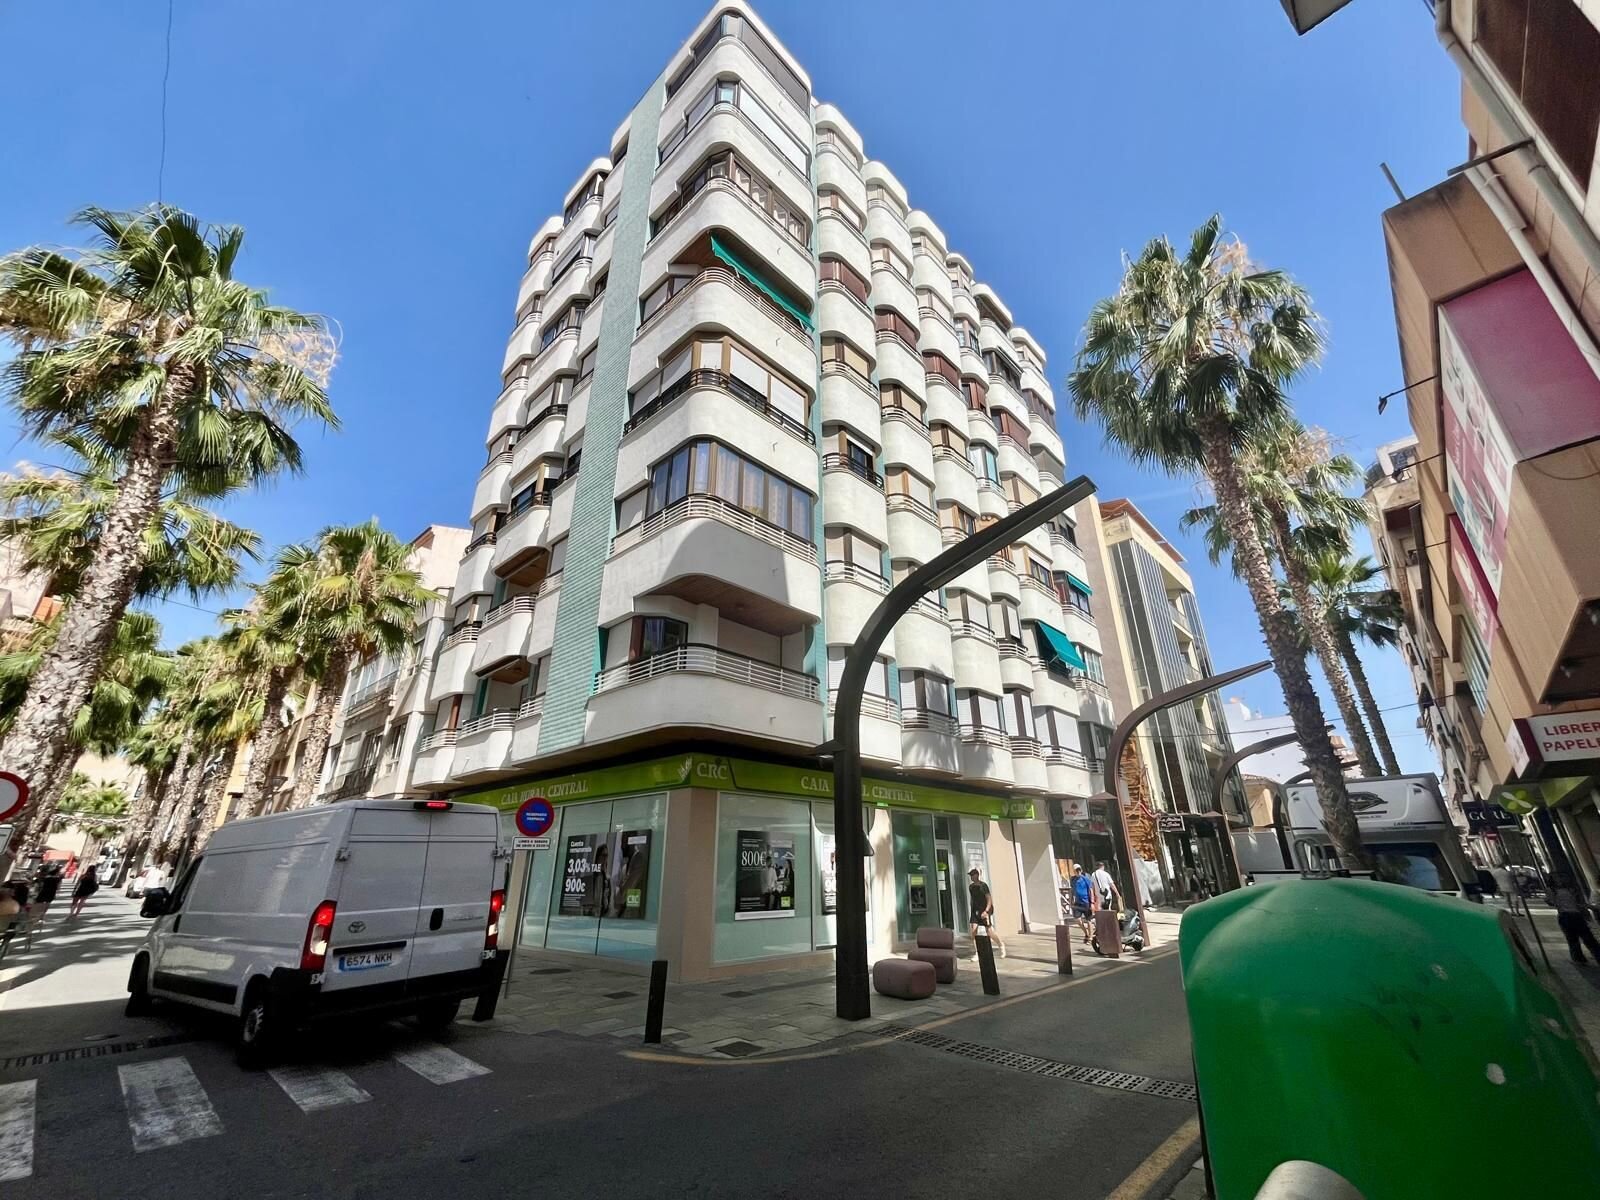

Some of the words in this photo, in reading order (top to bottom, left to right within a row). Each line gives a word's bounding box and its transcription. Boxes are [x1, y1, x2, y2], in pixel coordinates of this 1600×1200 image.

[1544, 721, 1600, 736] LIBRER
[696, 762, 728, 780] CRC
[547, 779, 589, 798] CENTRAL
[872, 785, 916, 802] CENTRAL
[741, 850, 767, 867] 800€
[591, 863, 602, 873] TAE
[346, 955, 371, 967] 6574
[374, 952, 392, 964] NKH
